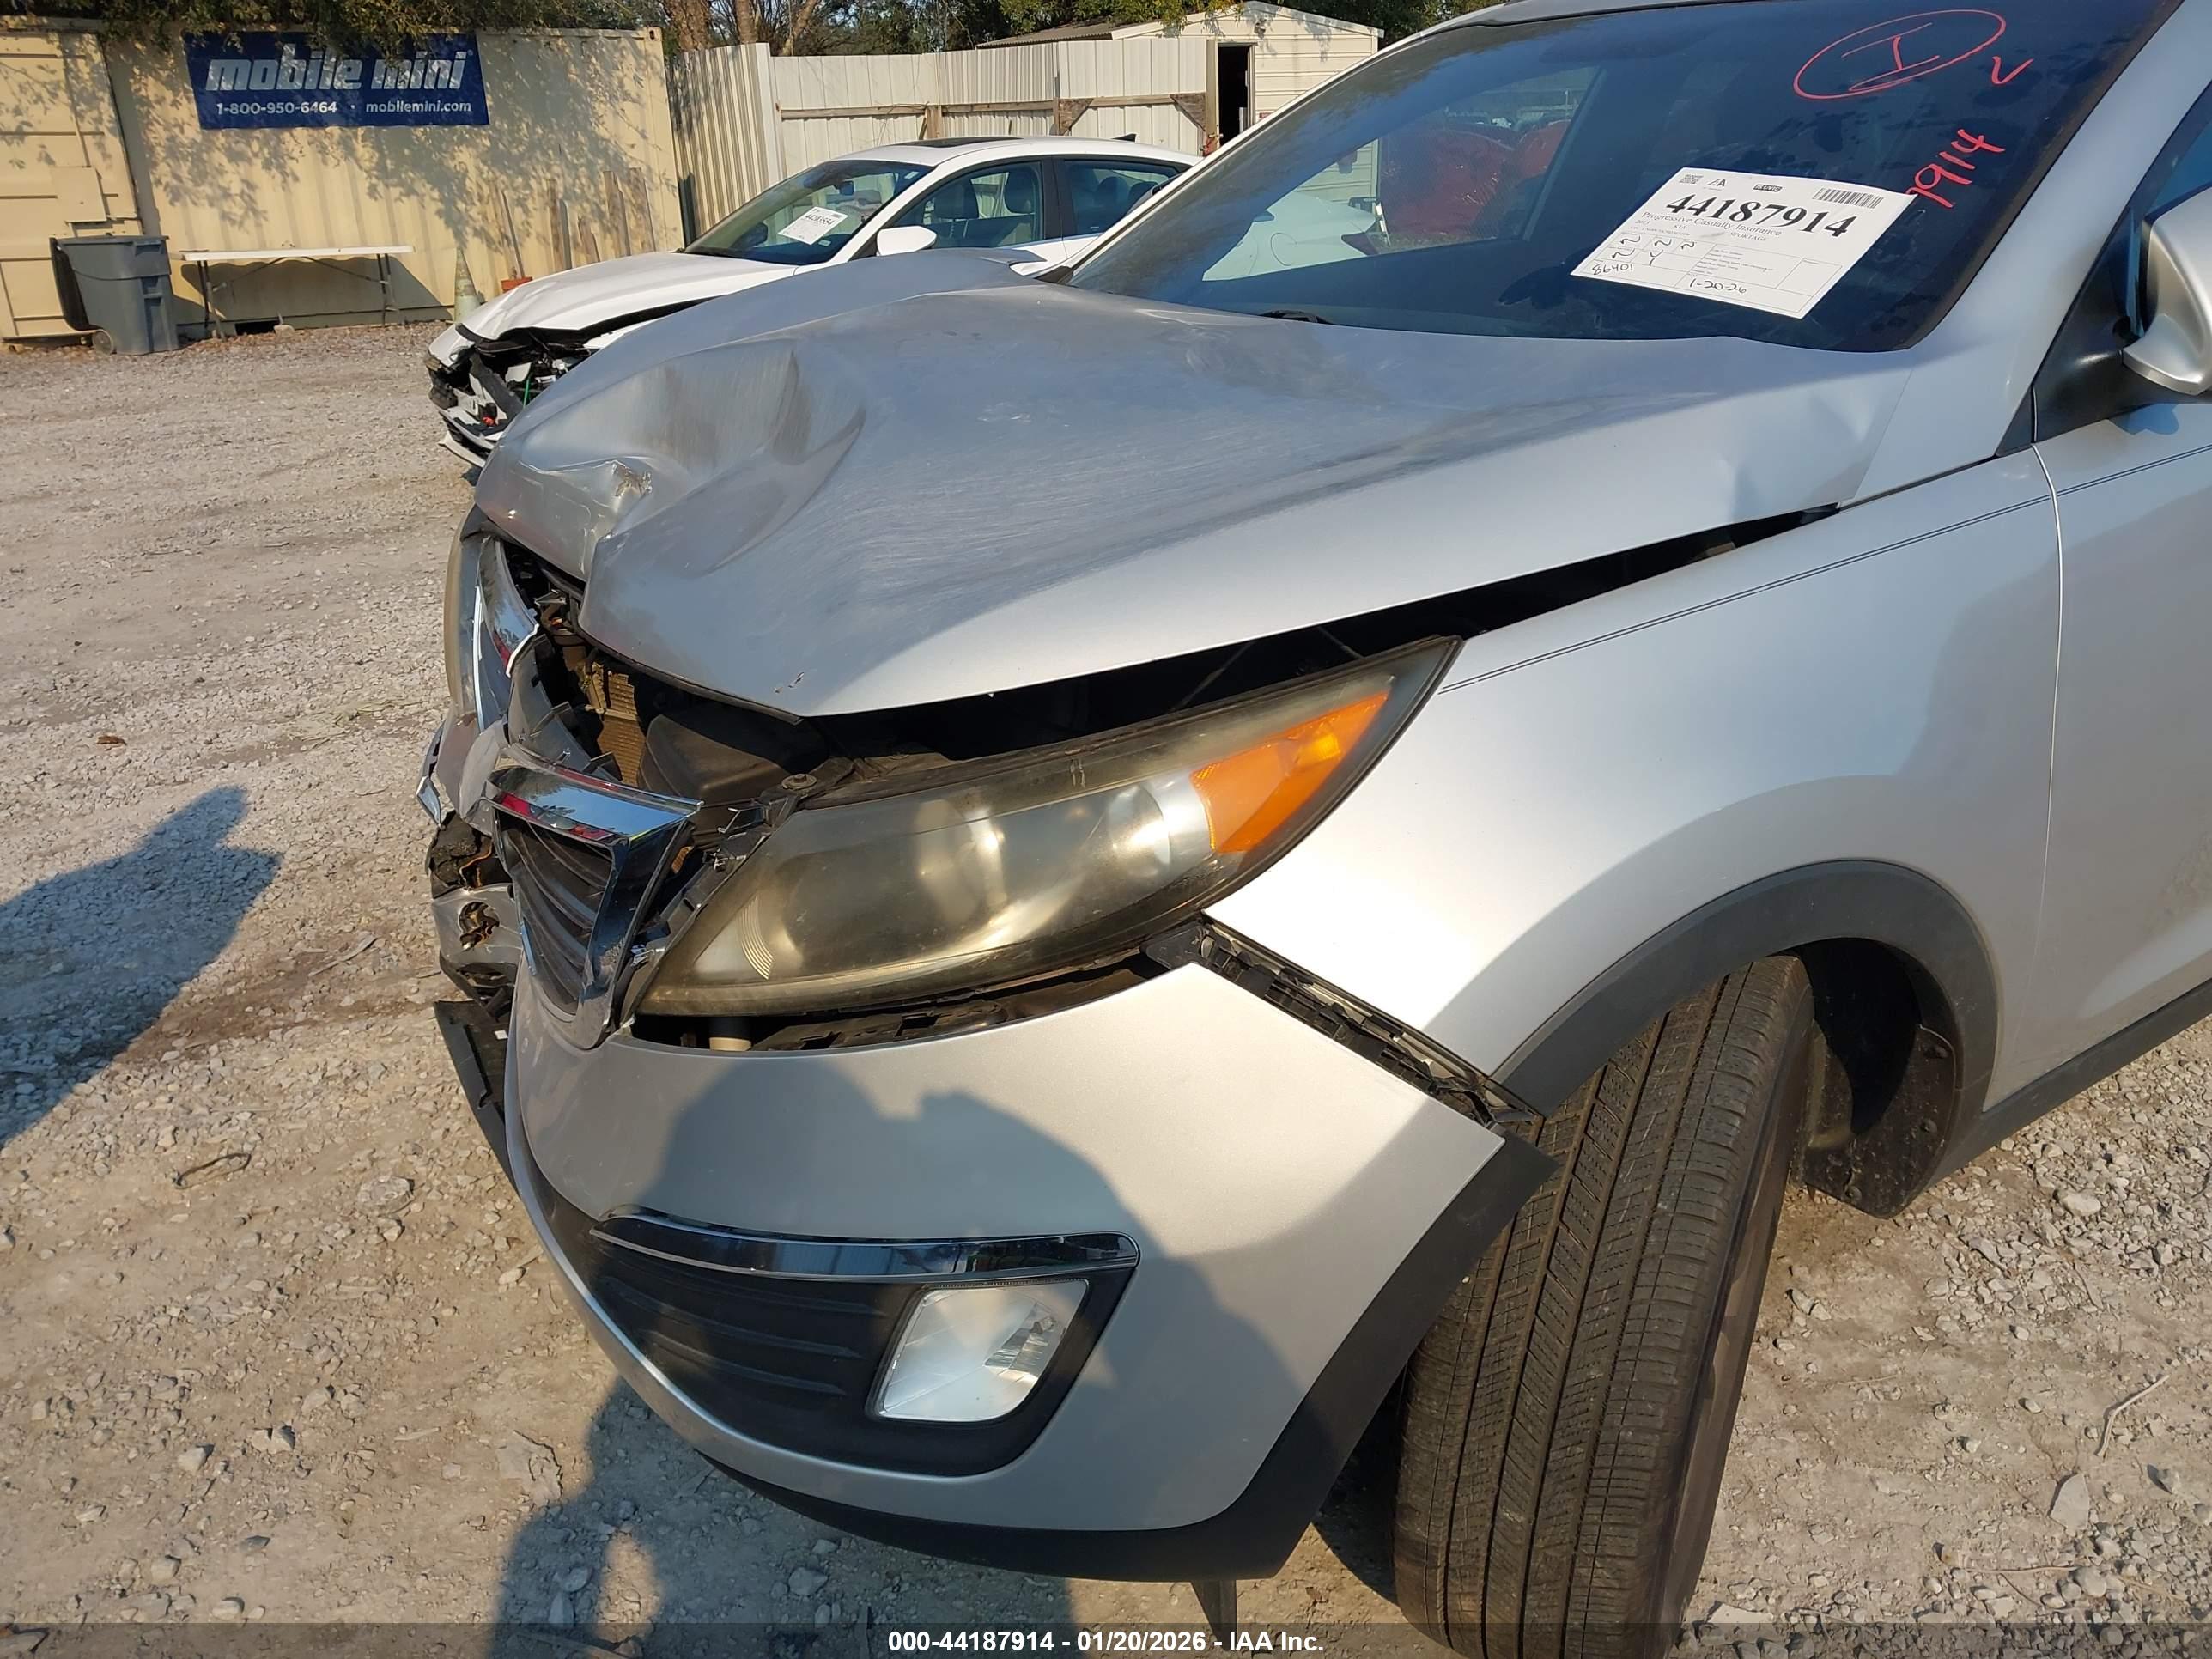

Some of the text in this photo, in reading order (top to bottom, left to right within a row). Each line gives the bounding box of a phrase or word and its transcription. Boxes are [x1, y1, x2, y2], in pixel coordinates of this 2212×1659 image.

[205, 43, 468, 91] mobile mini
[216, 100, 337, 115] 1-800-950-6464
[366, 100, 471, 113] mobilemini.com
[1641, 211, 1693, 224] Progressive
[1735, 222, 1783, 237] Insurance
[1666, 193, 1857, 238] 44187914
[1689, 277, 1747, 294] 1-20-26
